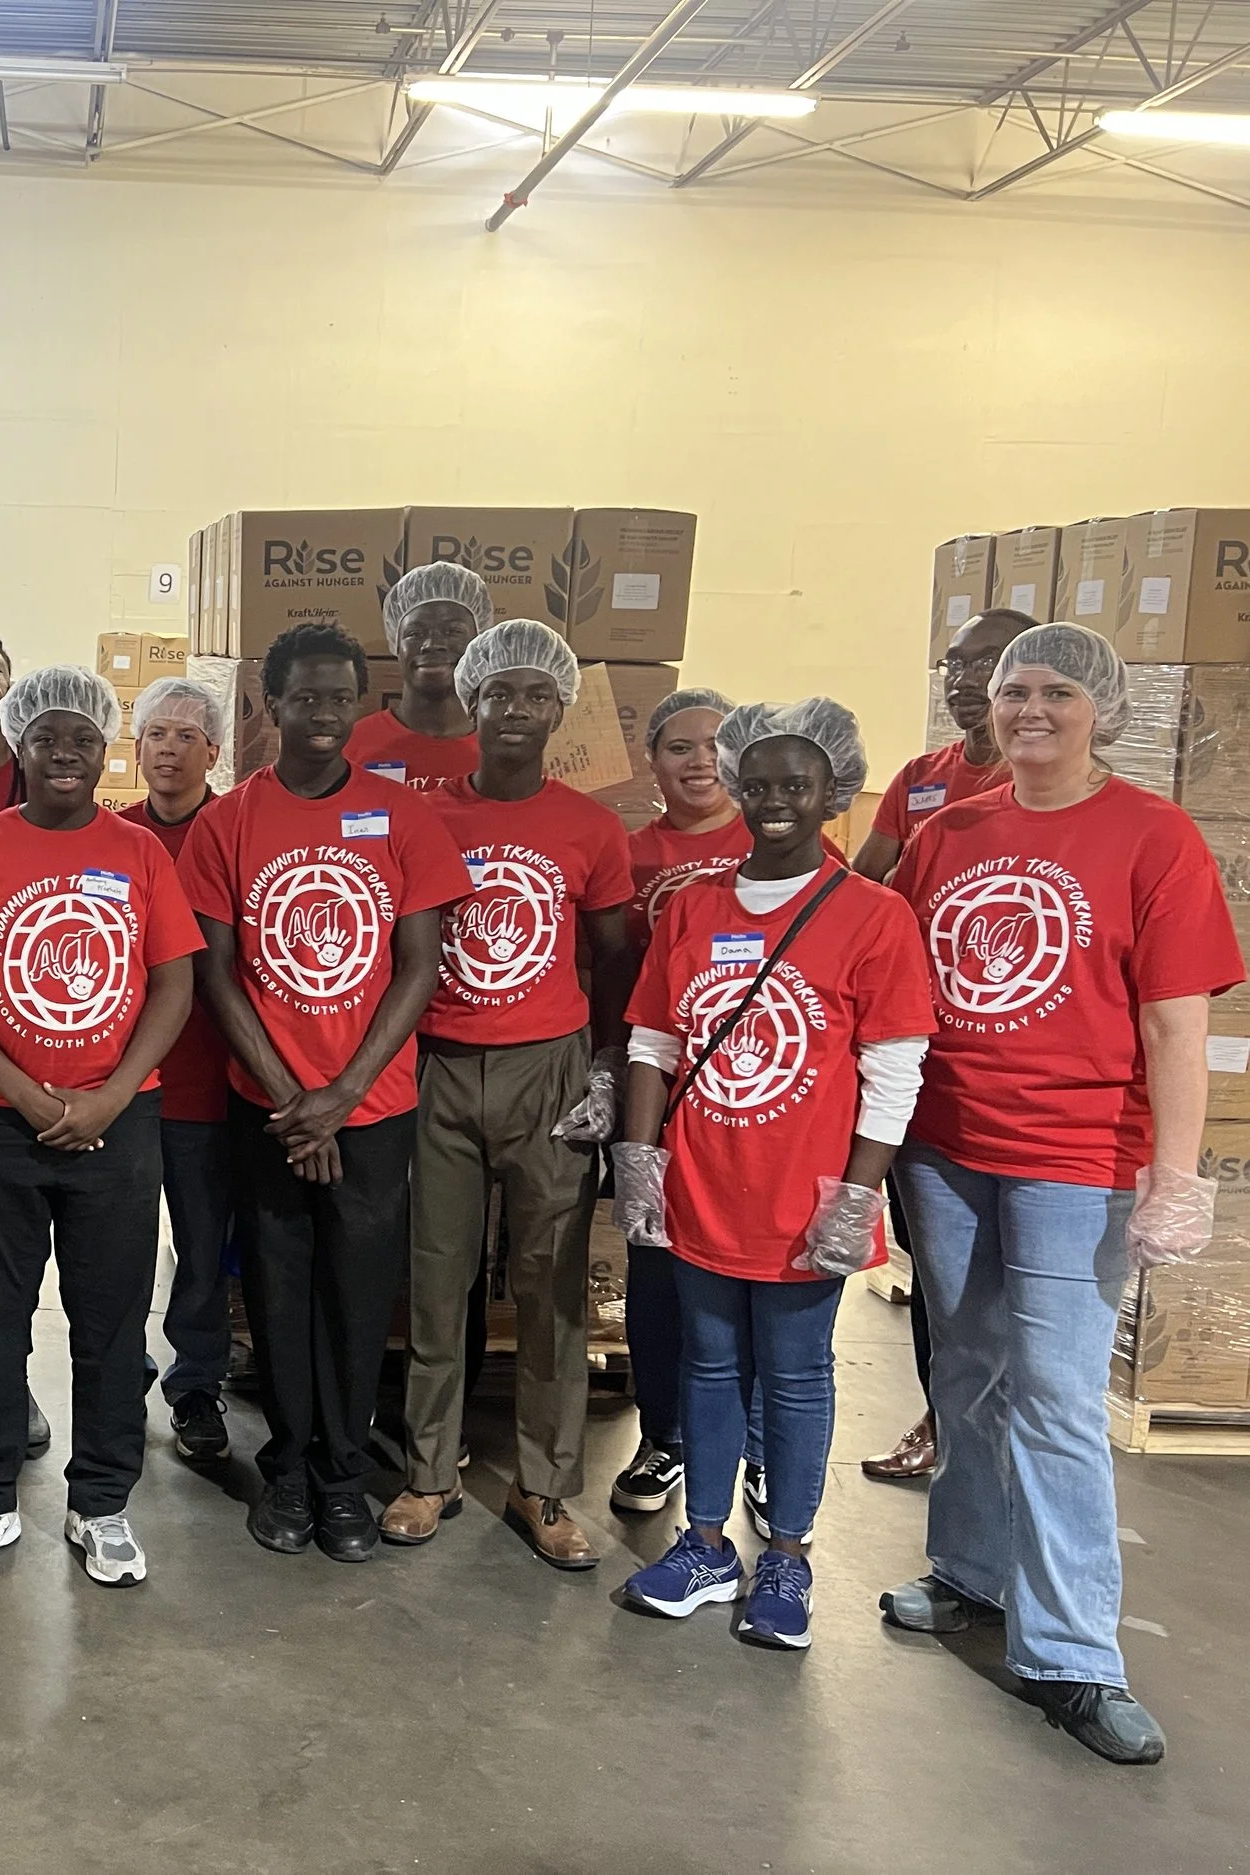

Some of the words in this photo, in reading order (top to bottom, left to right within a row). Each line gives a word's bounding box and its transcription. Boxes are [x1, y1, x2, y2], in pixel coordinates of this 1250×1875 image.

[264, 539, 365, 575] Rise
[431, 535, 533, 572] Rise
[159, 573, 173, 593] 9
[264, 578, 312, 587] AGAINST
[317, 577, 364, 586] HUNGER
[484, 575, 532, 584] HUNGER
[1215, 581, 1250, 590] AGAIN
[150, 646, 185, 660] Rise
[102, 799, 128, 810] Ris
[245, 846, 309, 909] COMMUNITY
[315, 845, 394, 922] TRANSFORMED
[501, 844, 567, 922] TRANSFORMED
[928, 855, 1020, 910] COMMUNITY
[1025, 857, 1094, 948] TRANSFORMED
[243, 915, 258, 926] A
[252, 957, 288, 1003] GLOBAL
[295, 1001, 338, 1015] YOUTH
[344, 989, 365, 1010] DAY
[438, 964, 454, 986] BAL
[455, 986, 500, 1006] YOUTH
[677, 963, 748, 1018] COMMUNITY
[760, 958, 827, 1031] TNSFORMED
[675, 1023, 690, 1032] A
[938, 1007, 987, 1034] YOUTH
[995, 1015, 1029, 1034] DAY
[1036, 984, 1073, 1019] 2025
[34, 1034, 84, 1048] YOUTH
[92, 1023, 115, 1043] DAY
[703, 1107, 749, 1127] YOUTH
[757, 1103, 787, 1124] DAY
[791, 1067, 818, 1104] 2025
